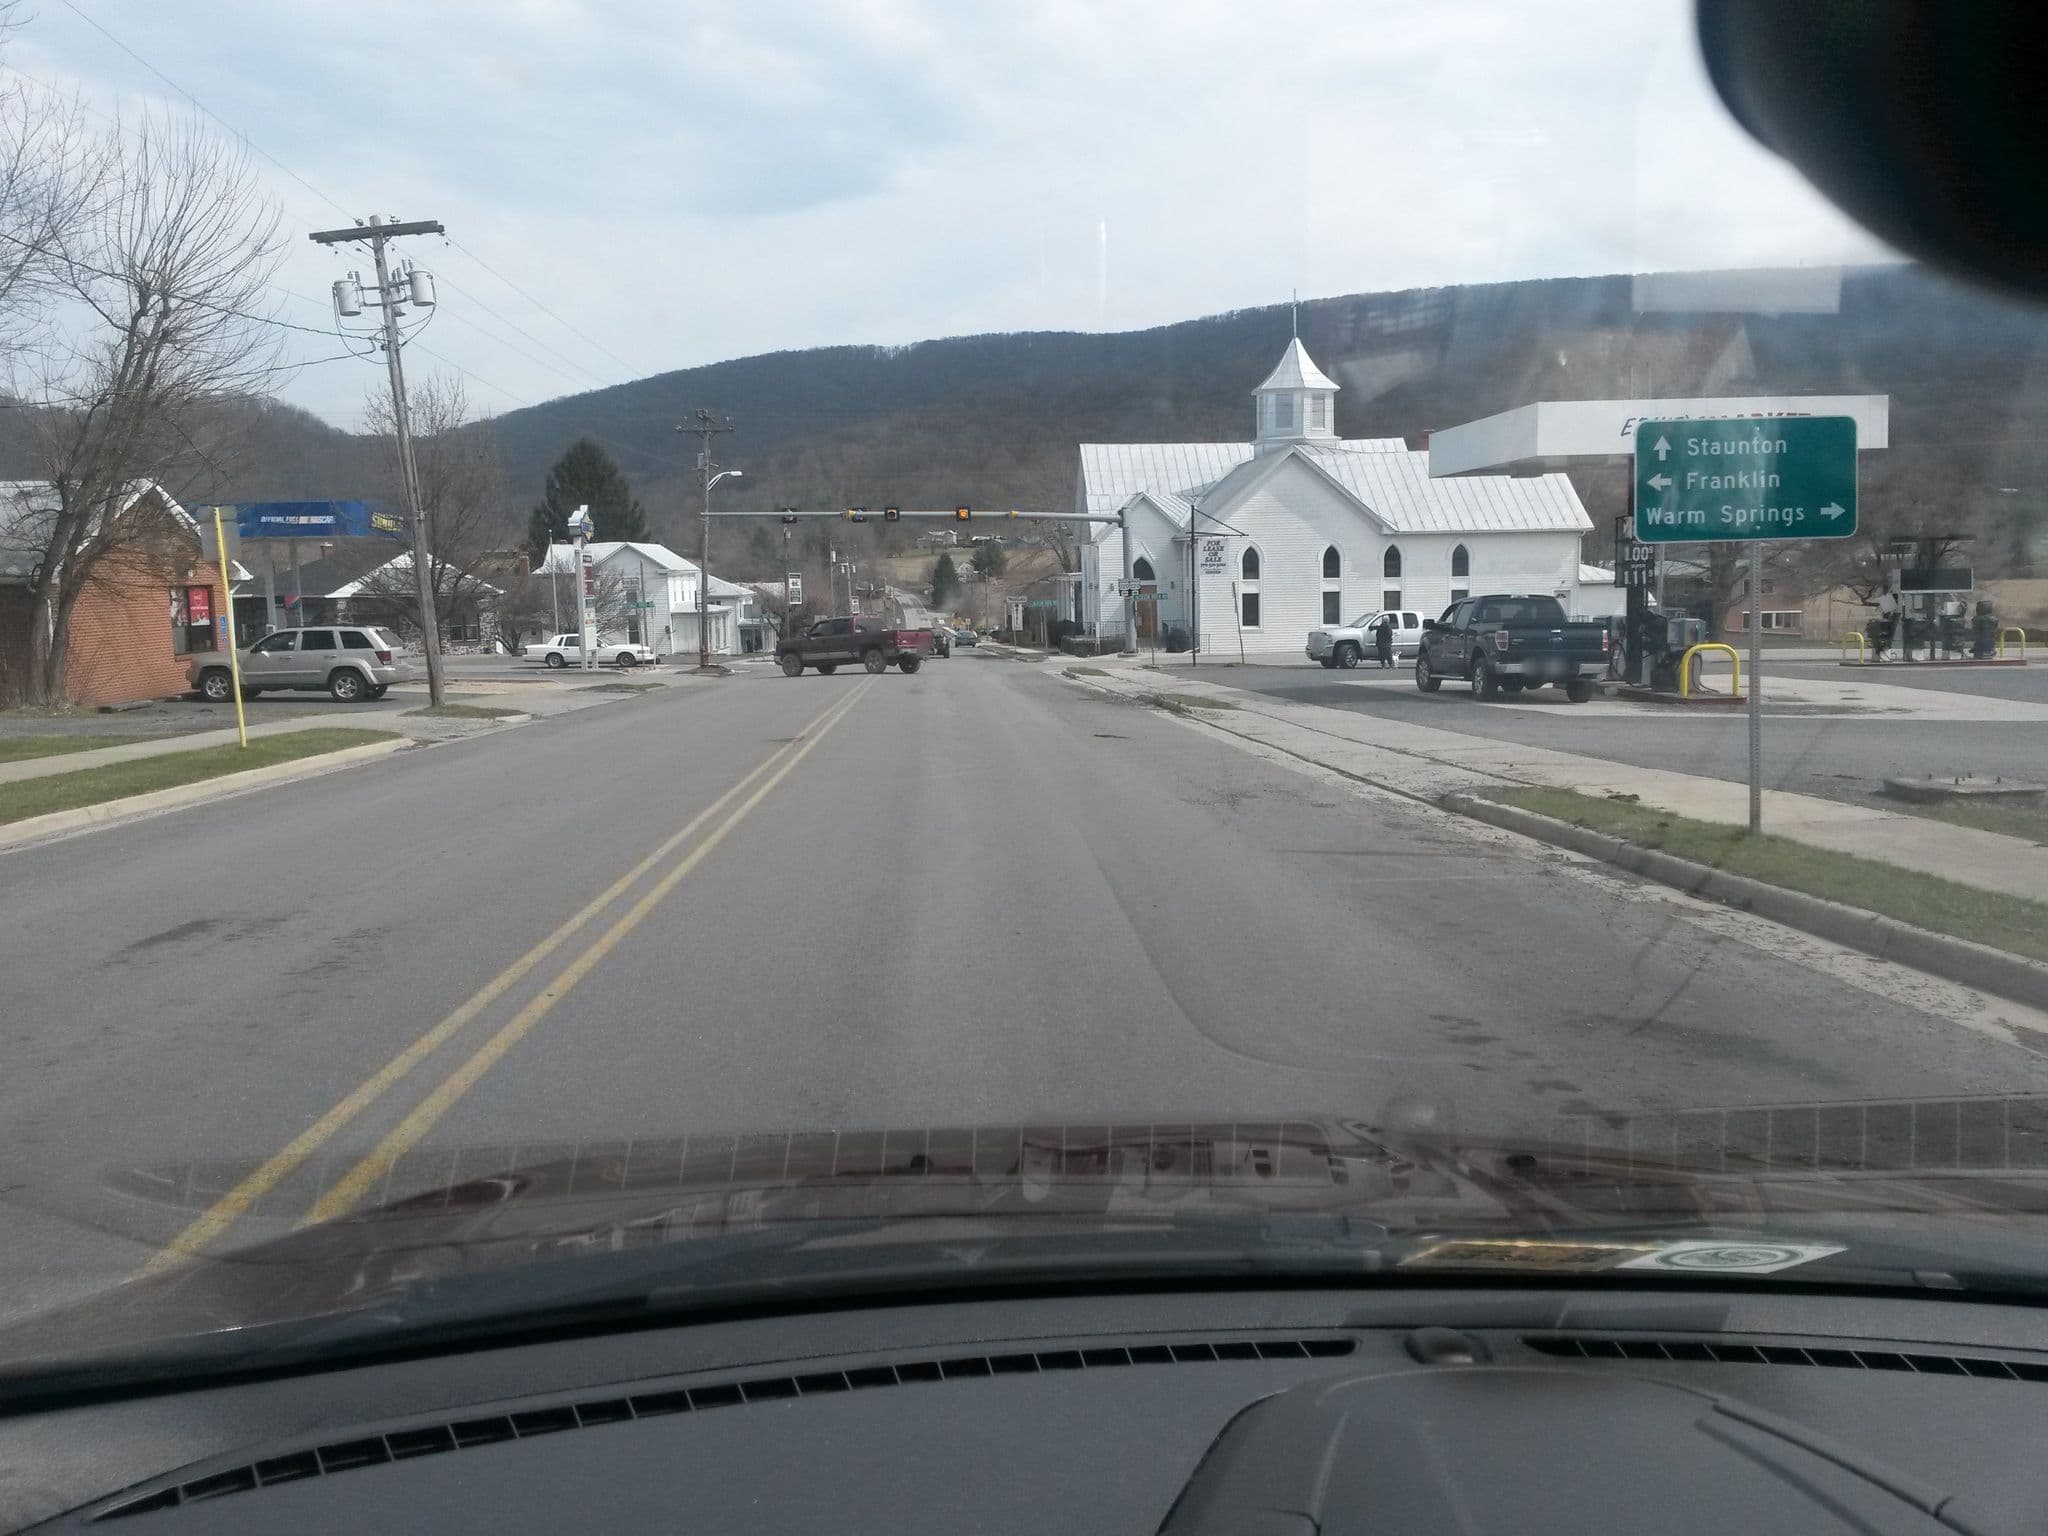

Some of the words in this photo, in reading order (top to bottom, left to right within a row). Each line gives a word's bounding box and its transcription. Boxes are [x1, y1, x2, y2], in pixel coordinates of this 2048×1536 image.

[1687, 436, 1788, 457] Staunton
[1686, 469, 1781, 491] Franklin
[1645, 506, 1706, 526] Warm
[1720, 504, 1806, 527] Springs
